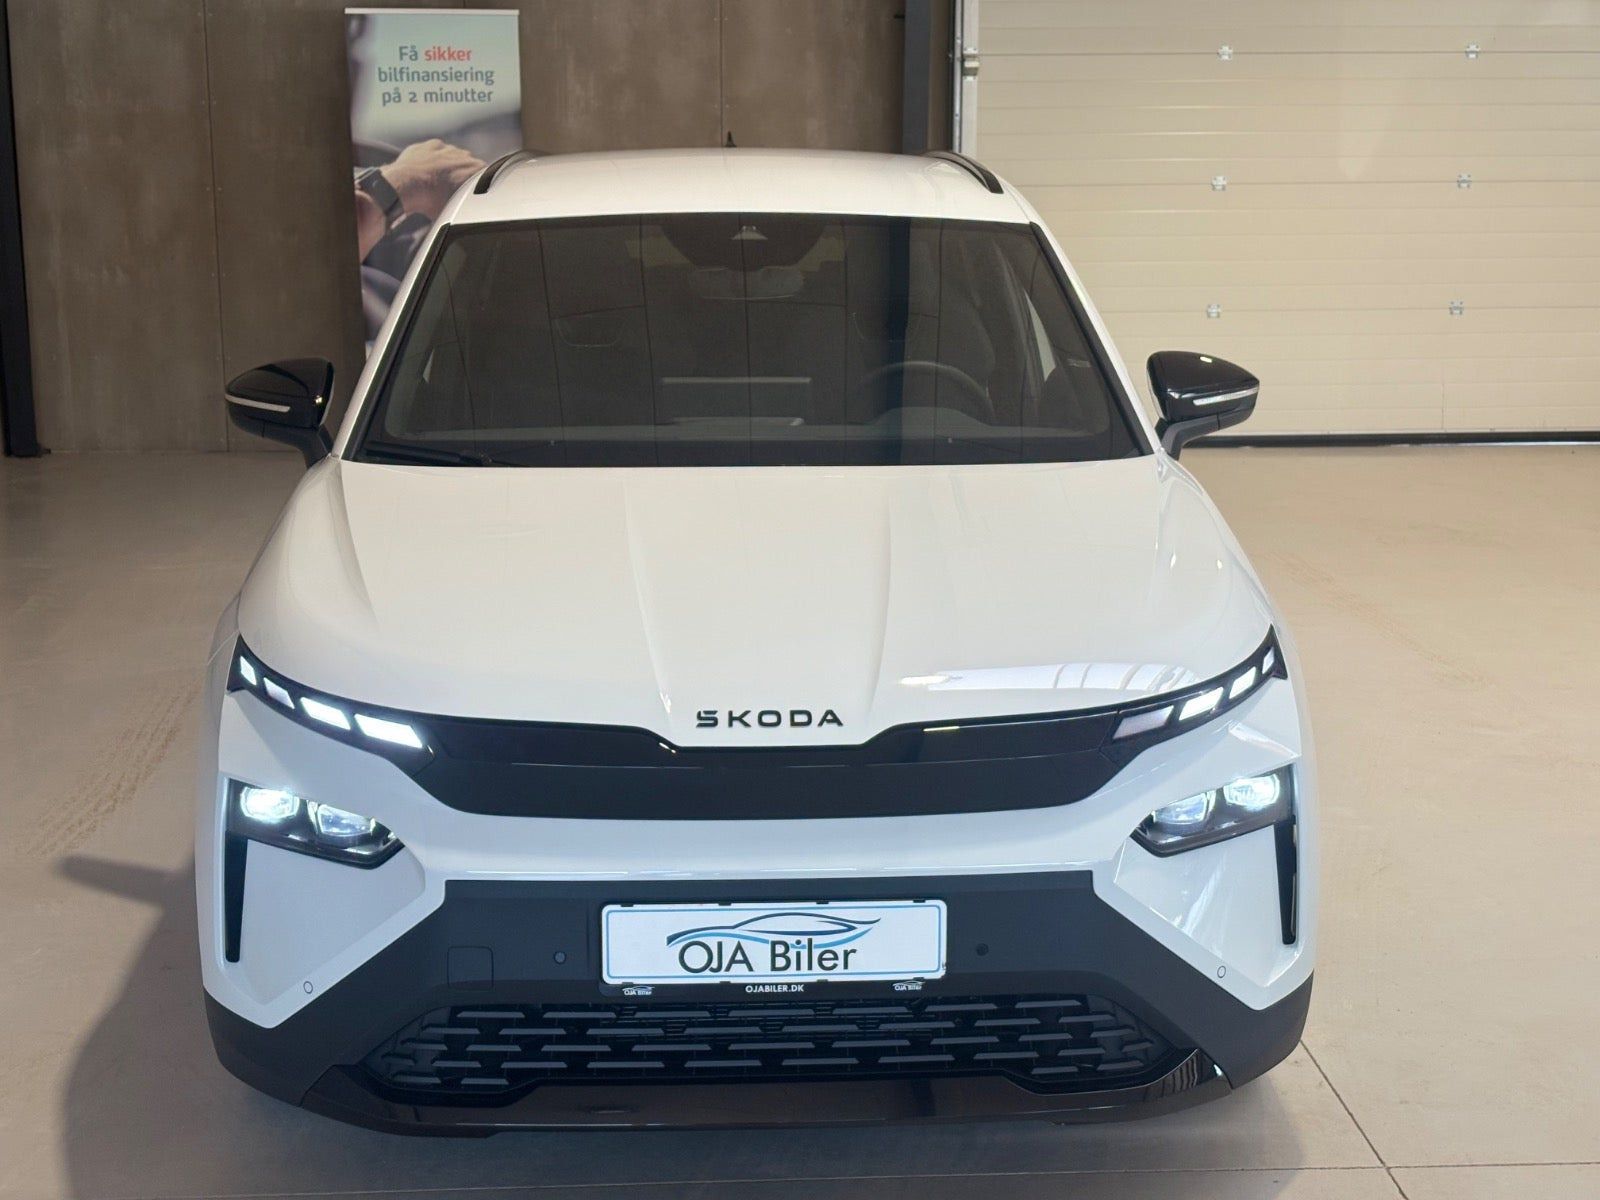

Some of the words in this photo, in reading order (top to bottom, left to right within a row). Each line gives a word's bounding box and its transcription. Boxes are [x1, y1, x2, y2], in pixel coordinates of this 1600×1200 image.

[398, 45, 418, 62] Få
[424, 46, 472, 62] sikker
[378, 67, 495, 86] bilfinansiering
[382, 87, 401, 107] på
[408, 91, 418, 103] 2
[424, 88, 493, 103] minutter
[678, 940, 754, 974] OJA
[769, 937, 857, 972] Biler
[745, 984, 805, 993] OJABILER.DK
